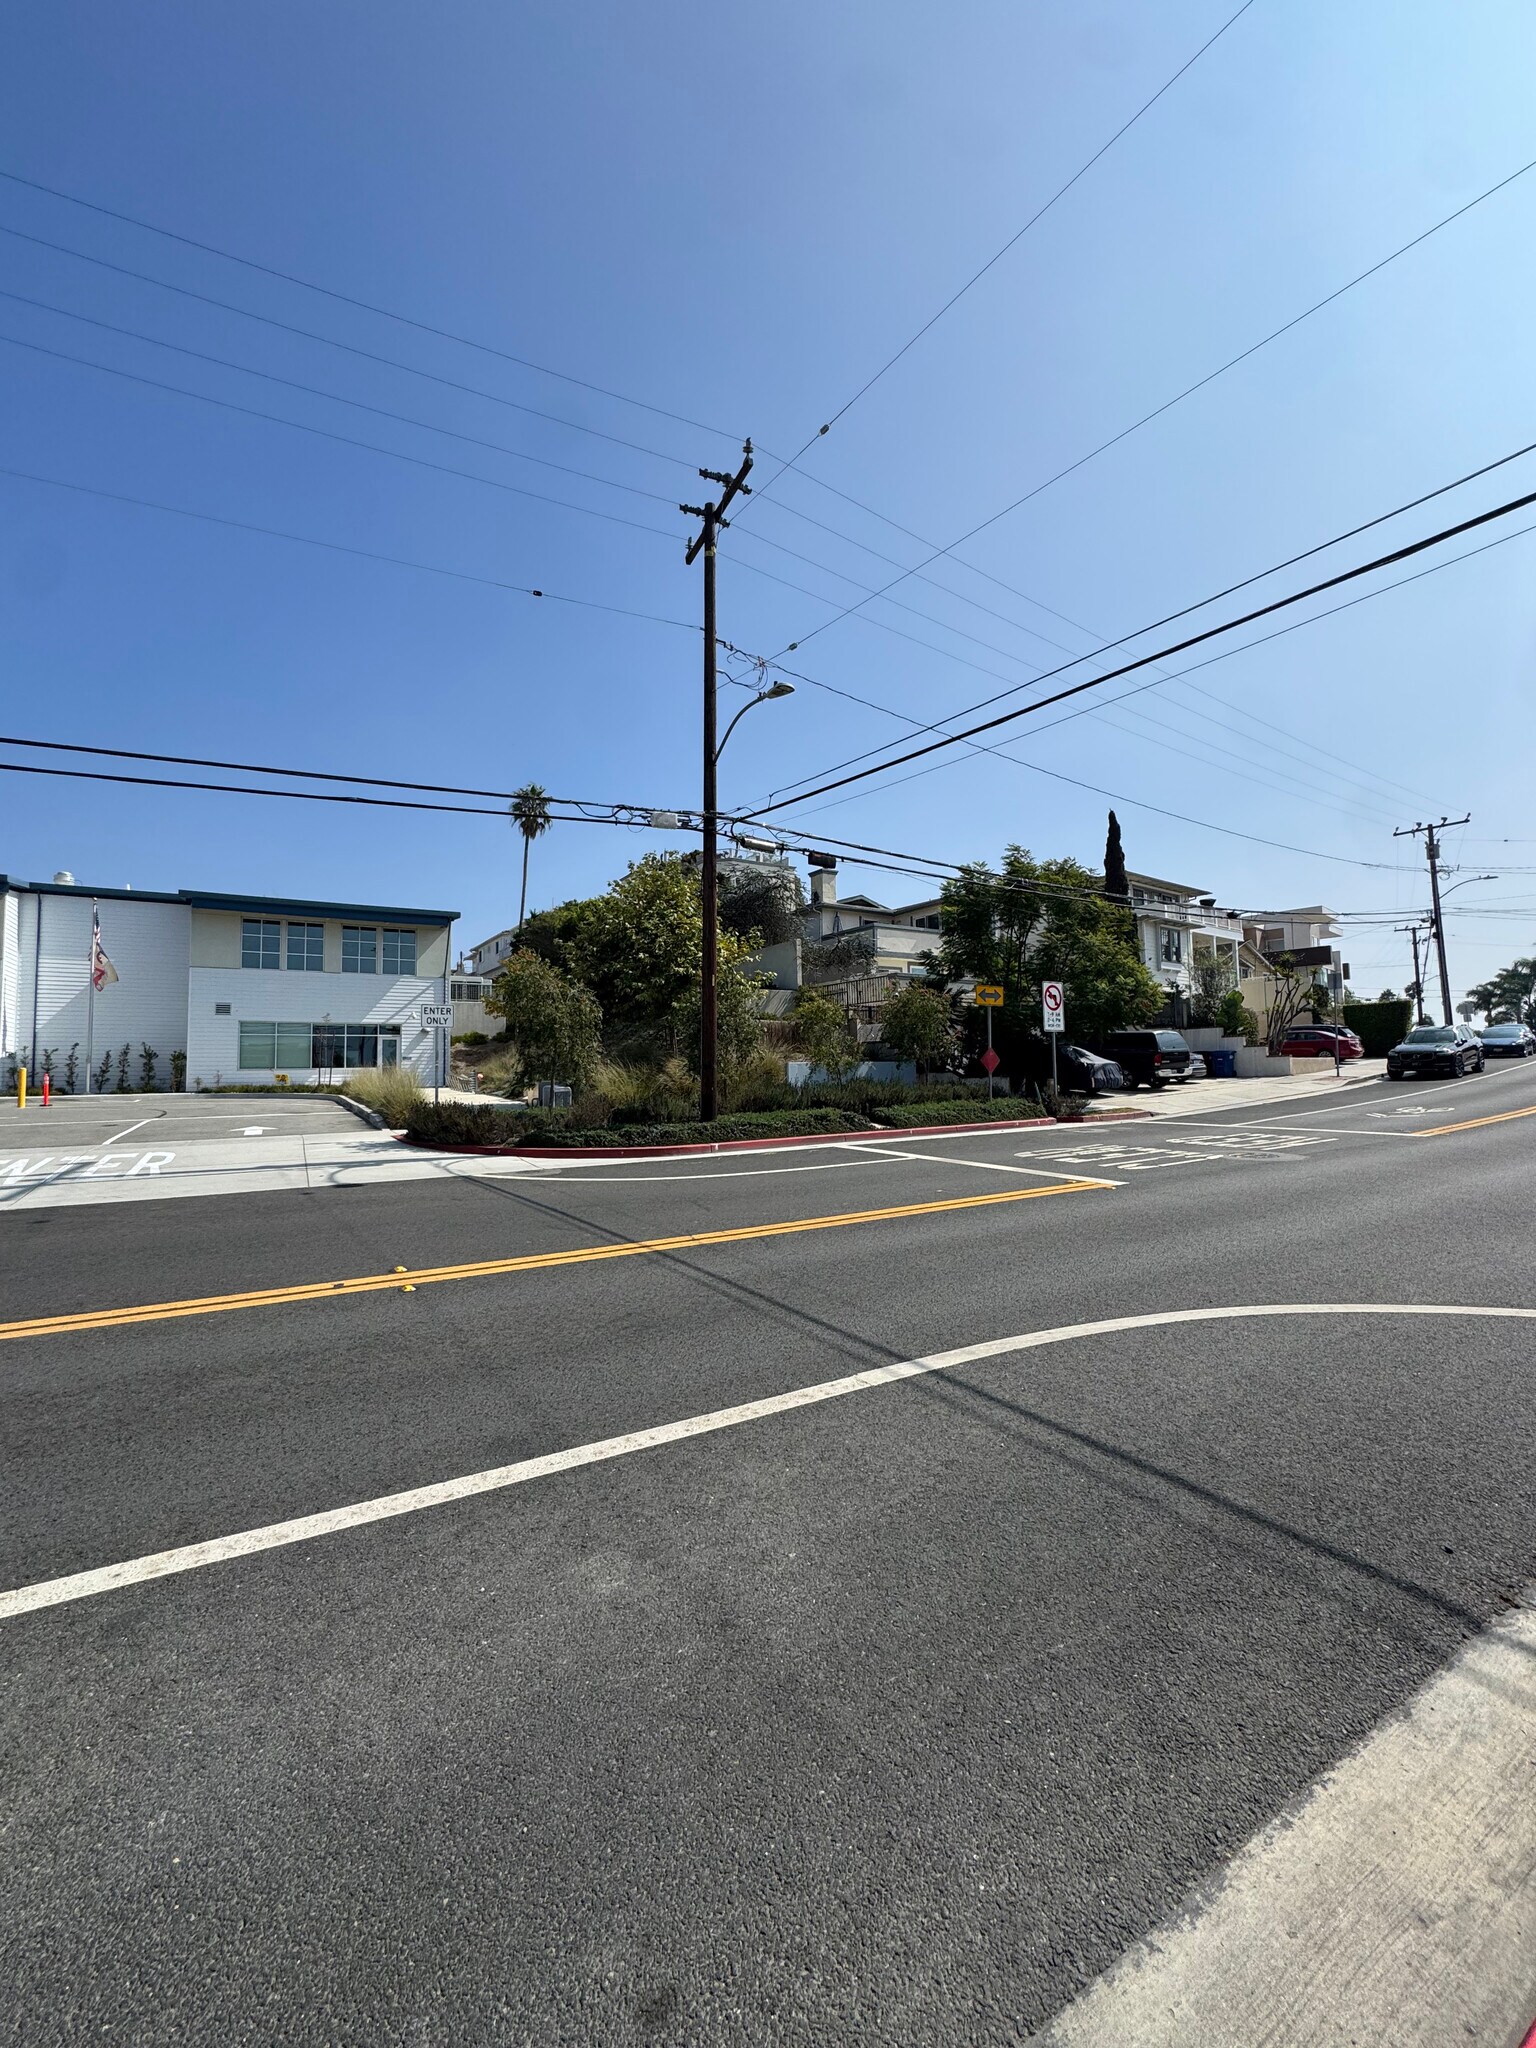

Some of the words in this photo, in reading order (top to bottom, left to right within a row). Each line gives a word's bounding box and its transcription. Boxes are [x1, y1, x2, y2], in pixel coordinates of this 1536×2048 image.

[424, 1007, 451, 1015] ENTER
[426, 1017, 449, 1025] ONLY
[1165, 1132, 1340, 1151] KEEP
[1013, 1143, 1225, 1170] CLEAR
